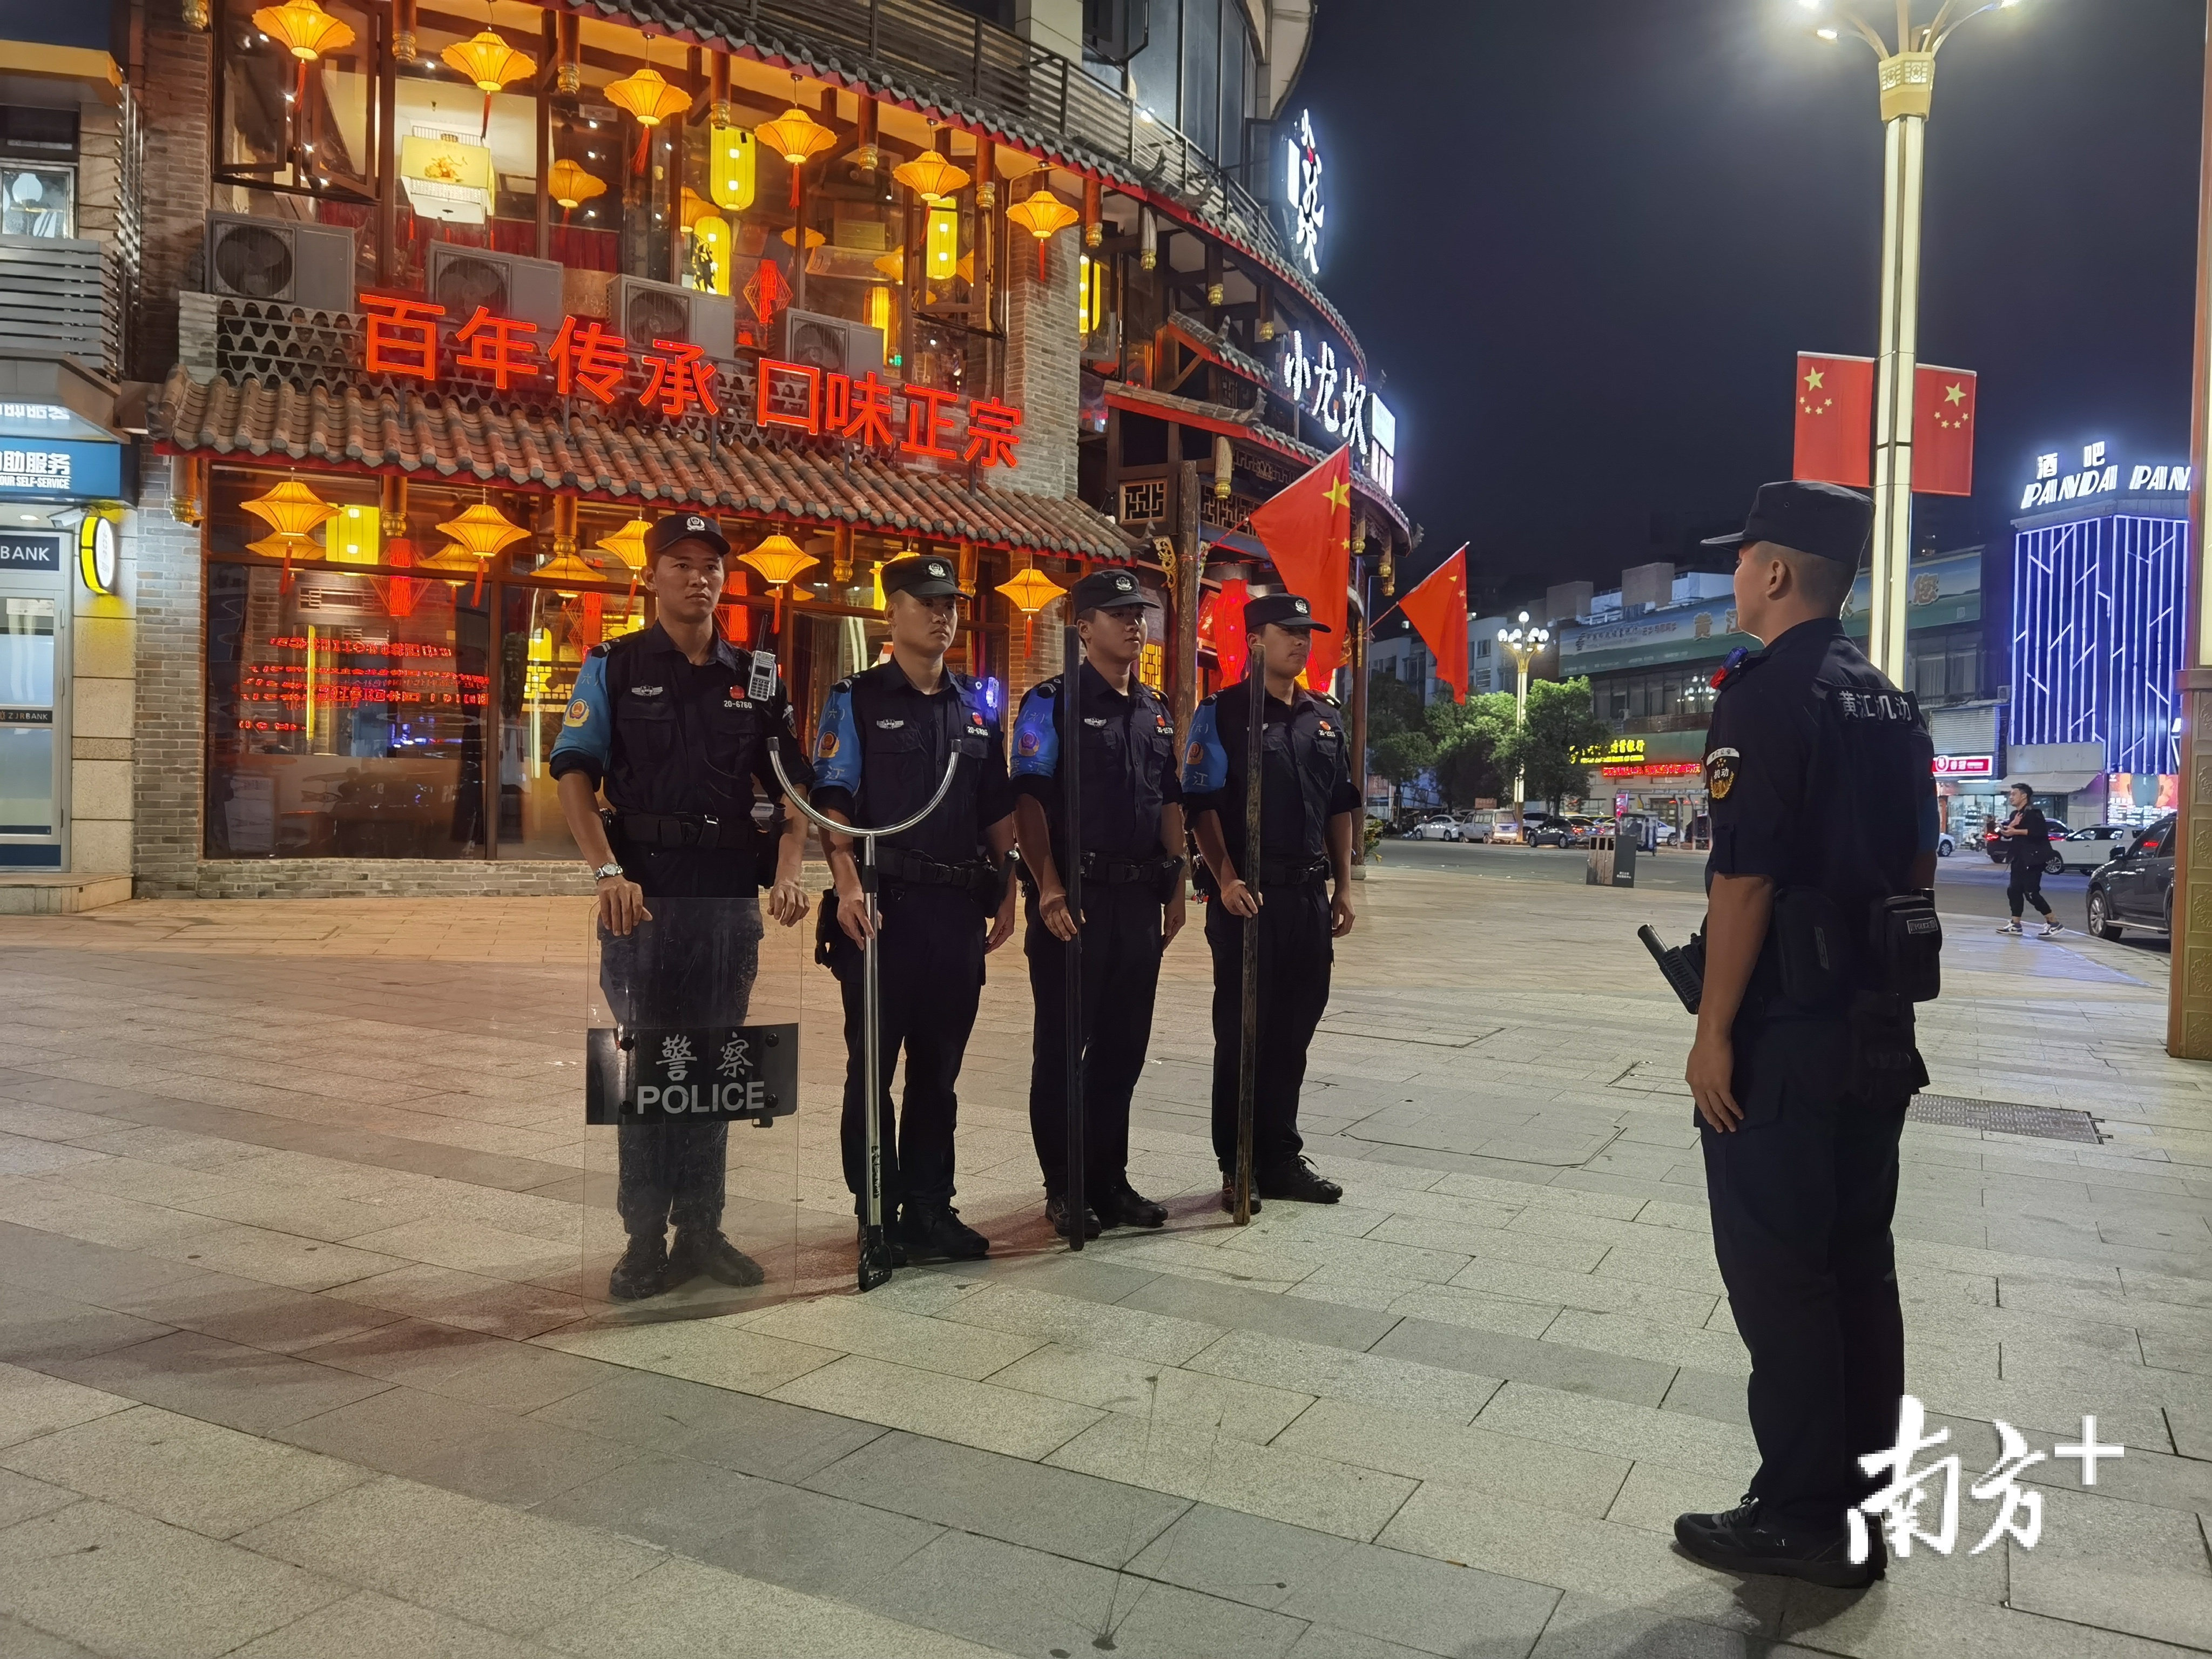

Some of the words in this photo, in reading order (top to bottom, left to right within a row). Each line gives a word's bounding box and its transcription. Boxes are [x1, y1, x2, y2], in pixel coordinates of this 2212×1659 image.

[360, 293, 719, 416] 百年传承
[757, 356, 1022, 469] 口味正宗
[1284, 330, 1367, 454] 小龙坎
[0, 450, 71, 475] 助服务
[2036, 441, 2106, 480] 酒吧
[16, 476, 71, 489] SELF-SERVICE
[2020, 464, 2118, 509] PANDA
[2128, 465, 2191, 491] PAN
[1, 545, 51, 561] BANK
[724, 700, 752, 709] 20-6760
[1714, 767, 1729, 779] 机动
[656, 1031, 753, 1081] 警察
[637, 1081, 765, 1115] POLICE
